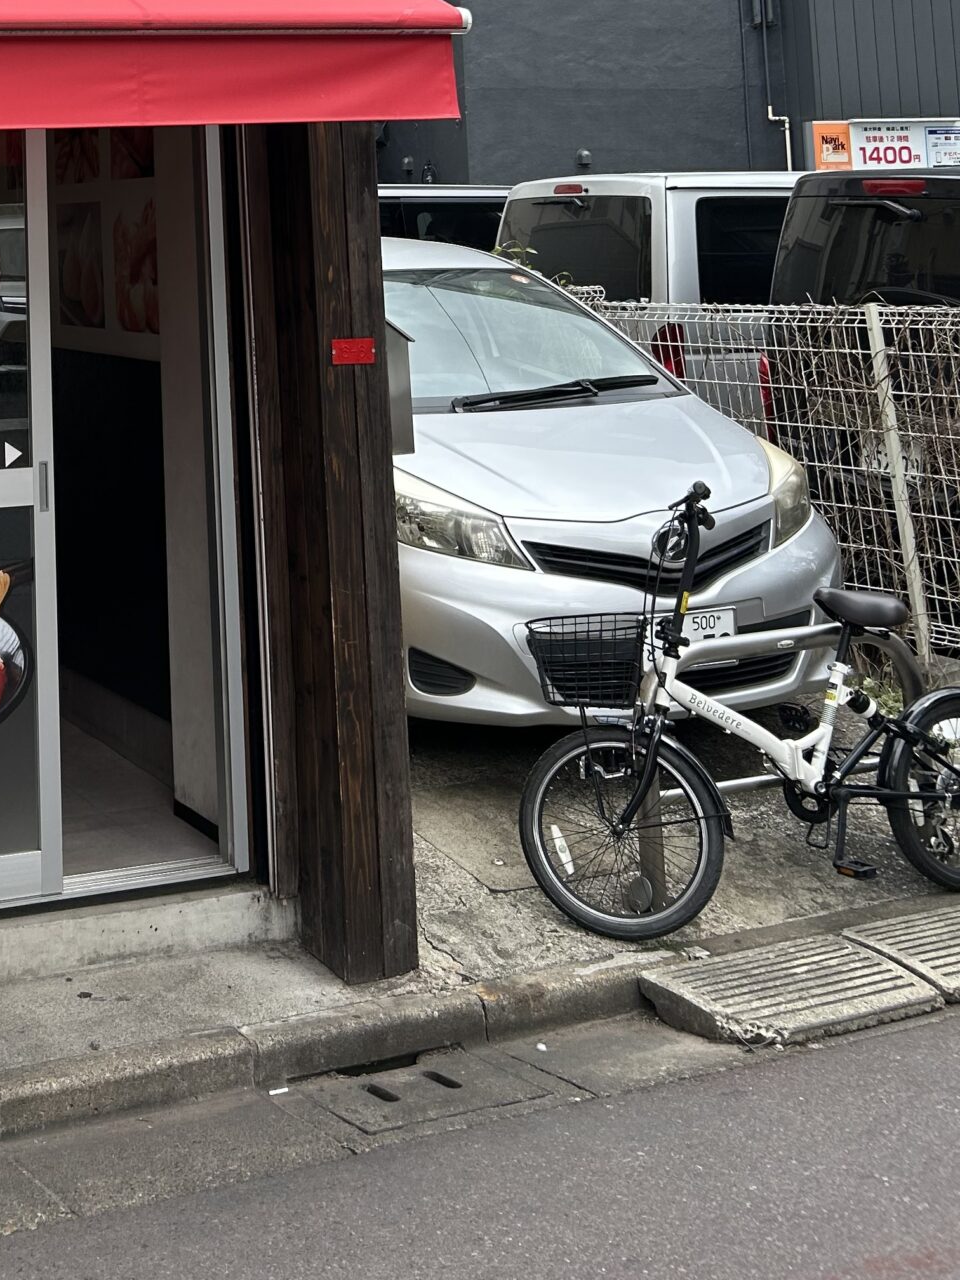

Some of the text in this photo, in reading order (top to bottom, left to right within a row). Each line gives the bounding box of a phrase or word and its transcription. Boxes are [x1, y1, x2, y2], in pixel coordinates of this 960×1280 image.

[821, 135, 840, 145] Navi
[692, 614, 716, 631] 500
[688, 693, 742, 730] Belvedere
